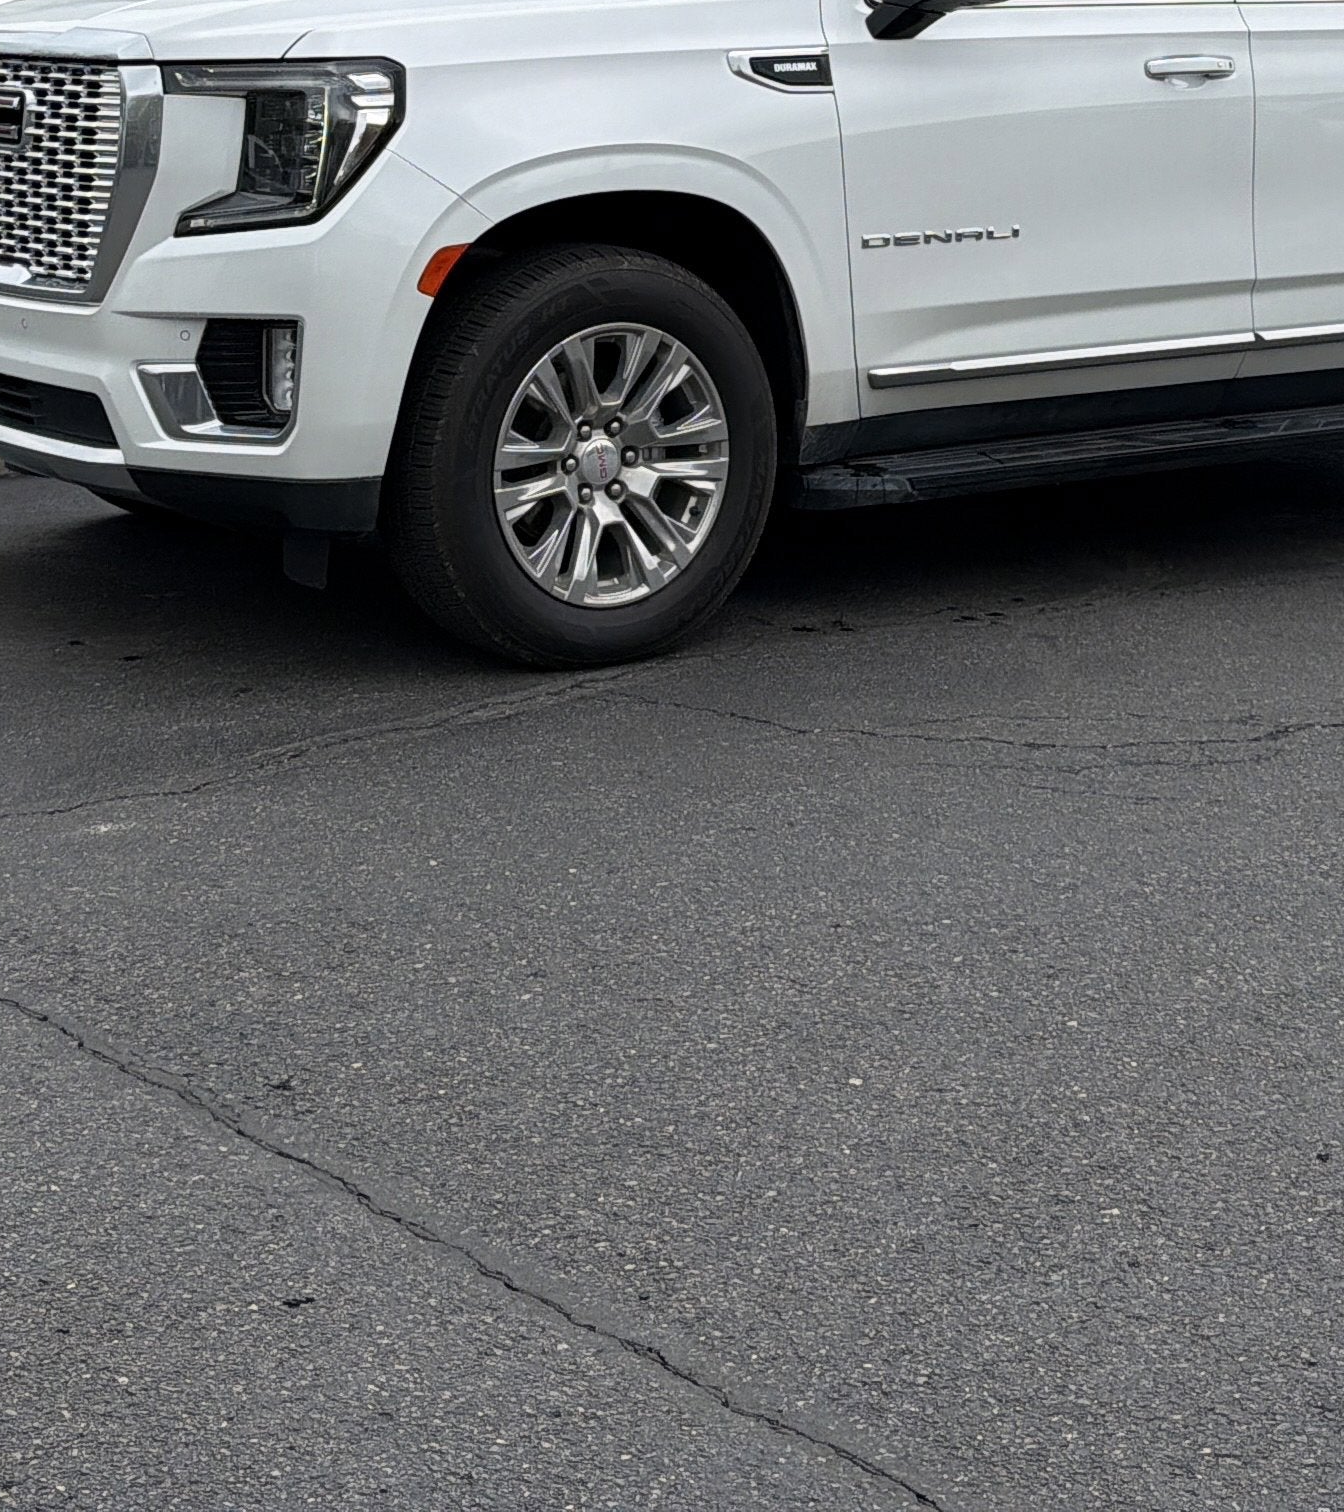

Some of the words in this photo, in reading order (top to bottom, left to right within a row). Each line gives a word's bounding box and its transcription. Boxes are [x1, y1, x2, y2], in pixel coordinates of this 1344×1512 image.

[773, 61, 818, 73] DURAMAX
[861, 224, 1020, 250] DENALI
[596, 442, 608, 479] GMC
